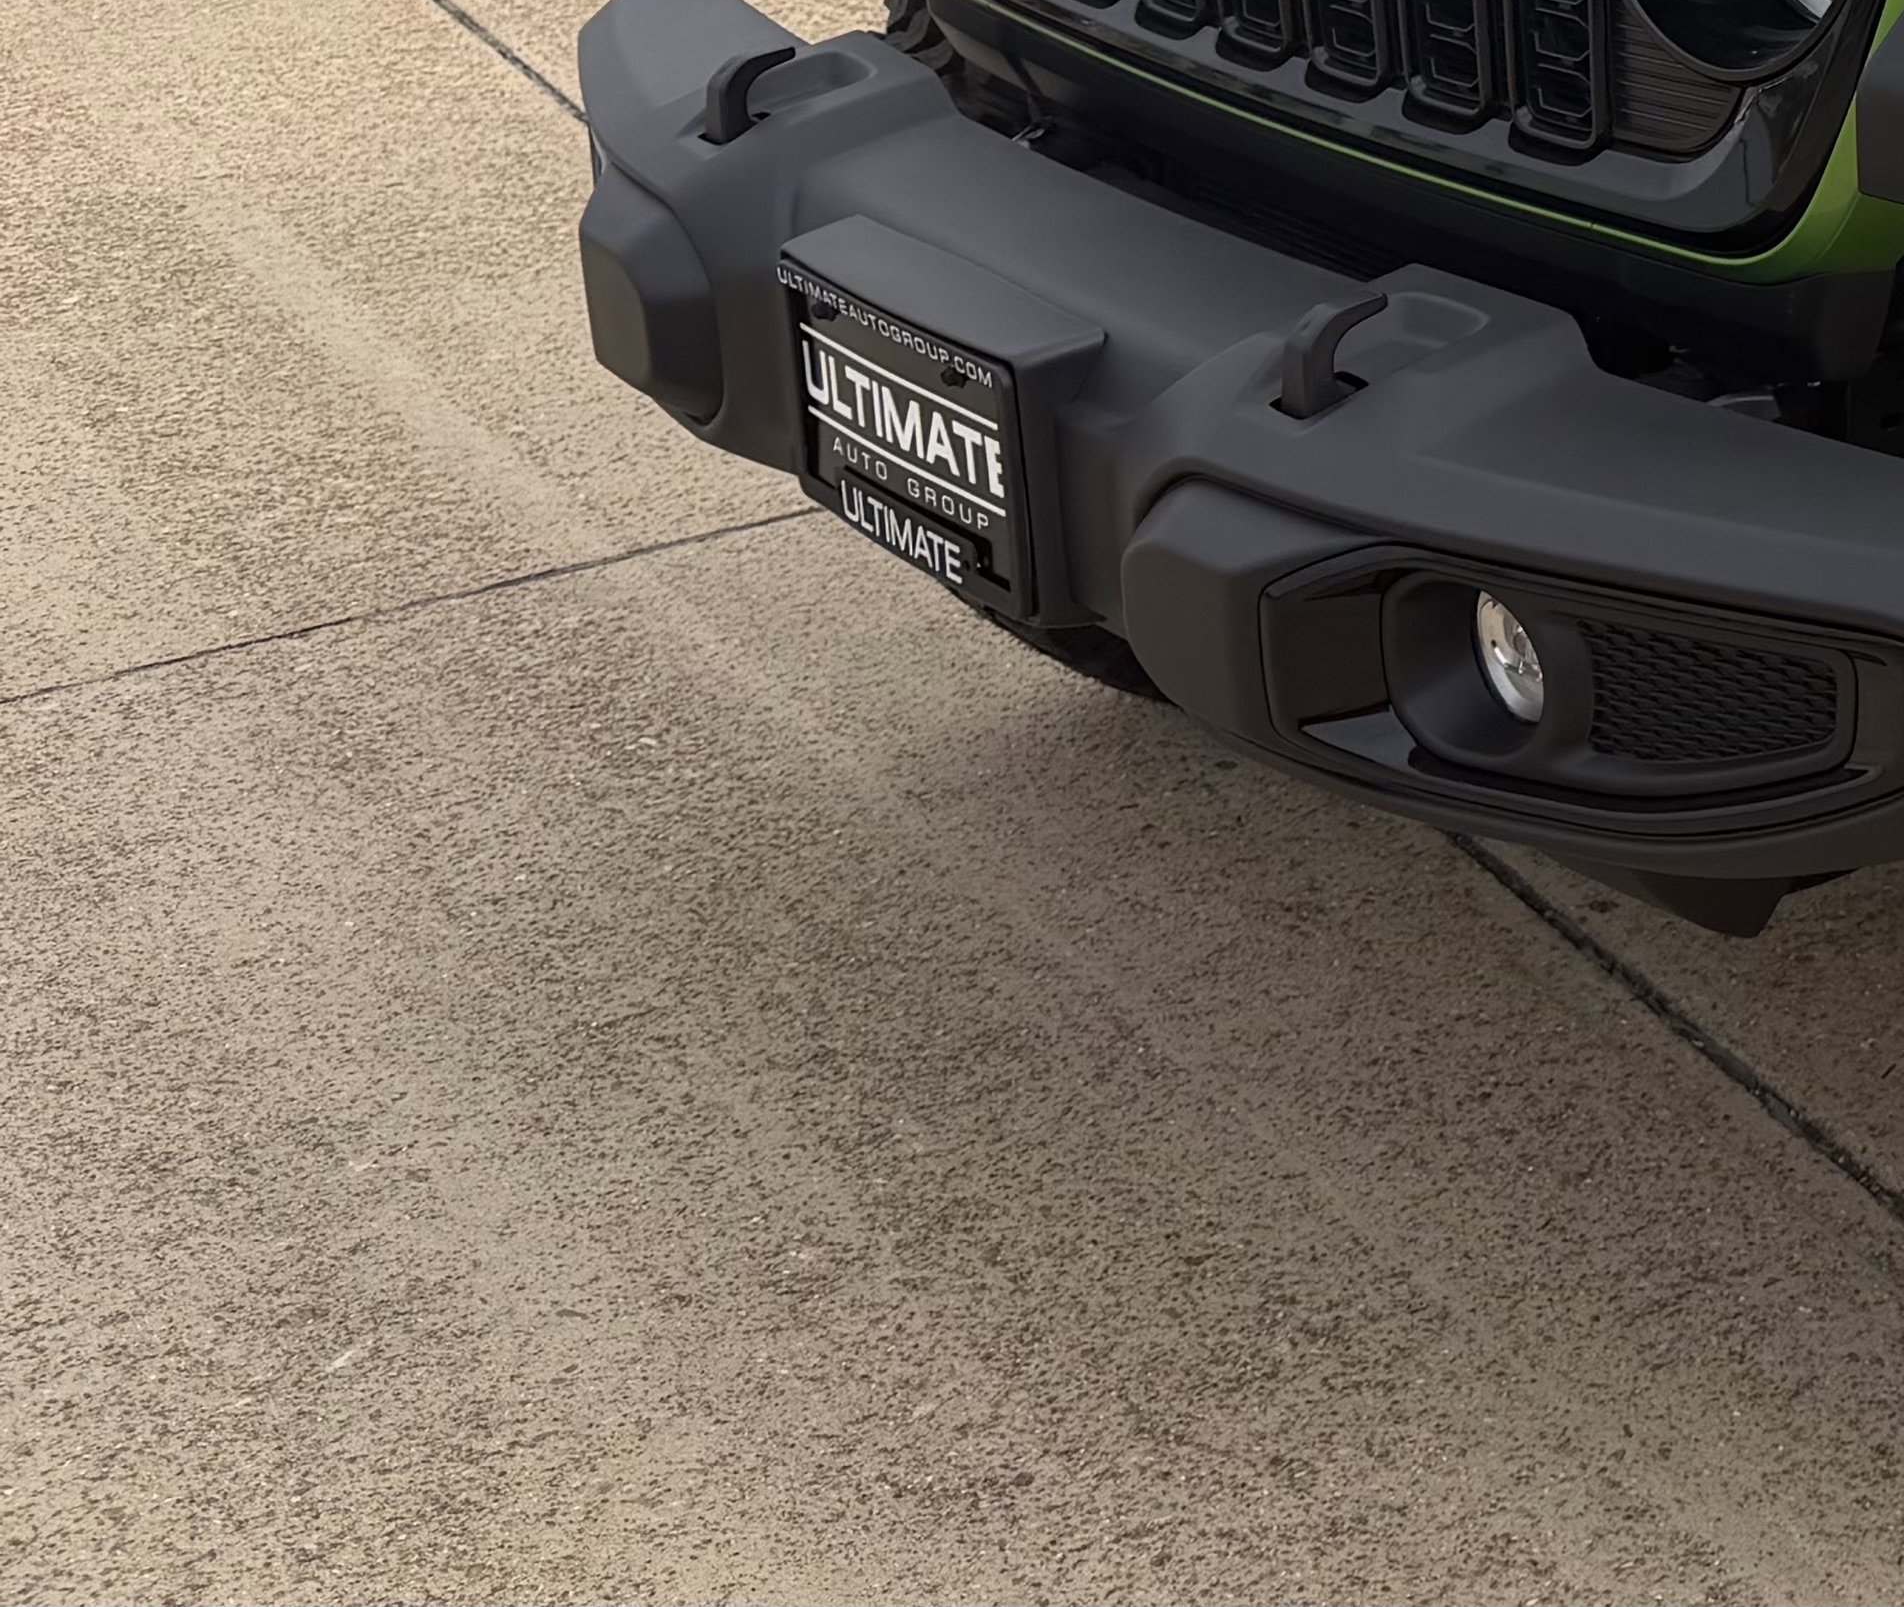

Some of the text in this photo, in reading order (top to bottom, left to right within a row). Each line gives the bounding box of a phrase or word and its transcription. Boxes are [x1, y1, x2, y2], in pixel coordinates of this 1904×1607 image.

[776, 265, 994, 389] ULTIMATEAUTOGROUP.COM
[800, 339, 1006, 499] ULTIMATE
[832, 436, 991, 532] AUTO GROUP
[839, 480, 964, 585] ULTIMATE
